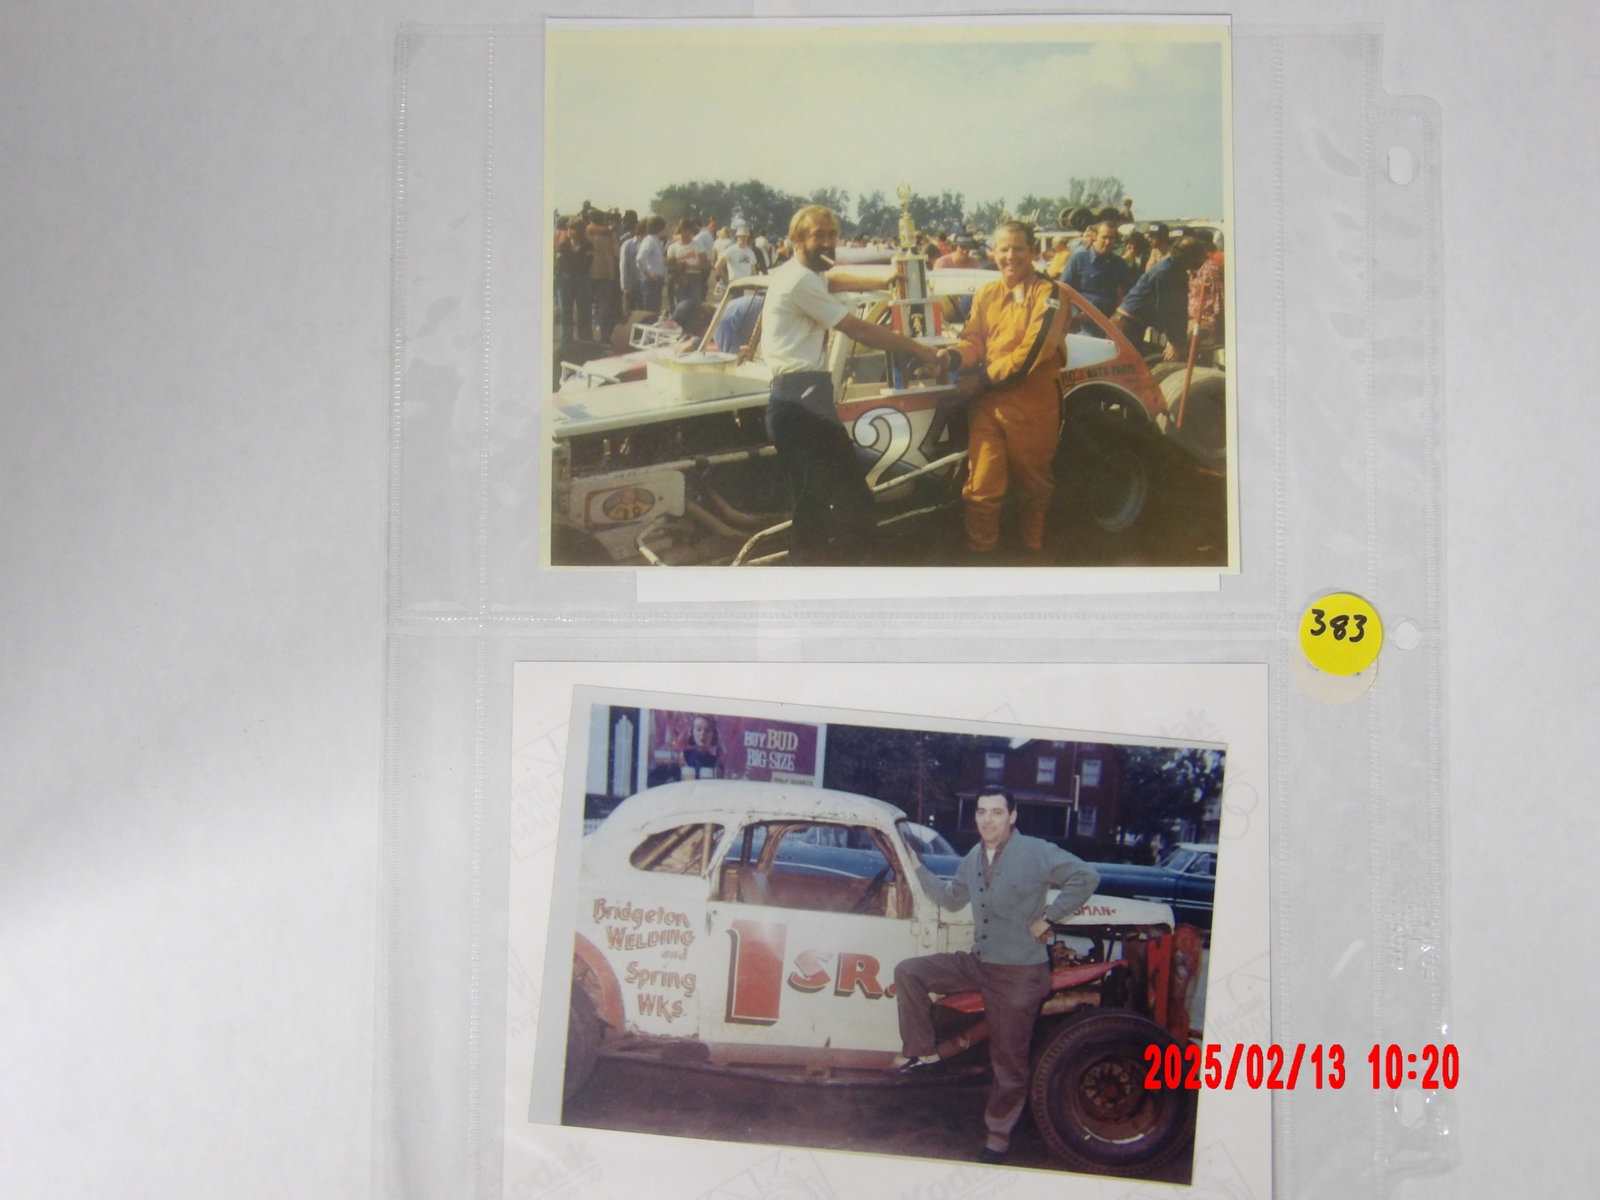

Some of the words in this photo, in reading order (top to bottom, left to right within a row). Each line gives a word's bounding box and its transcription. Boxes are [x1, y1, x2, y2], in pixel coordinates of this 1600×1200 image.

[1310, 608, 1367, 643] 383
[744, 731, 767, 749] BUY
[767, 728, 799, 751] BUD
[747, 749, 768, 768] BIG
[769, 751, 795, 771] SIZE
[592, 897, 692, 930] Bridgeton
[606, 925, 696, 951] WELDING
[660, 947, 689, 960] and
[624, 960, 697, 998] Spring
